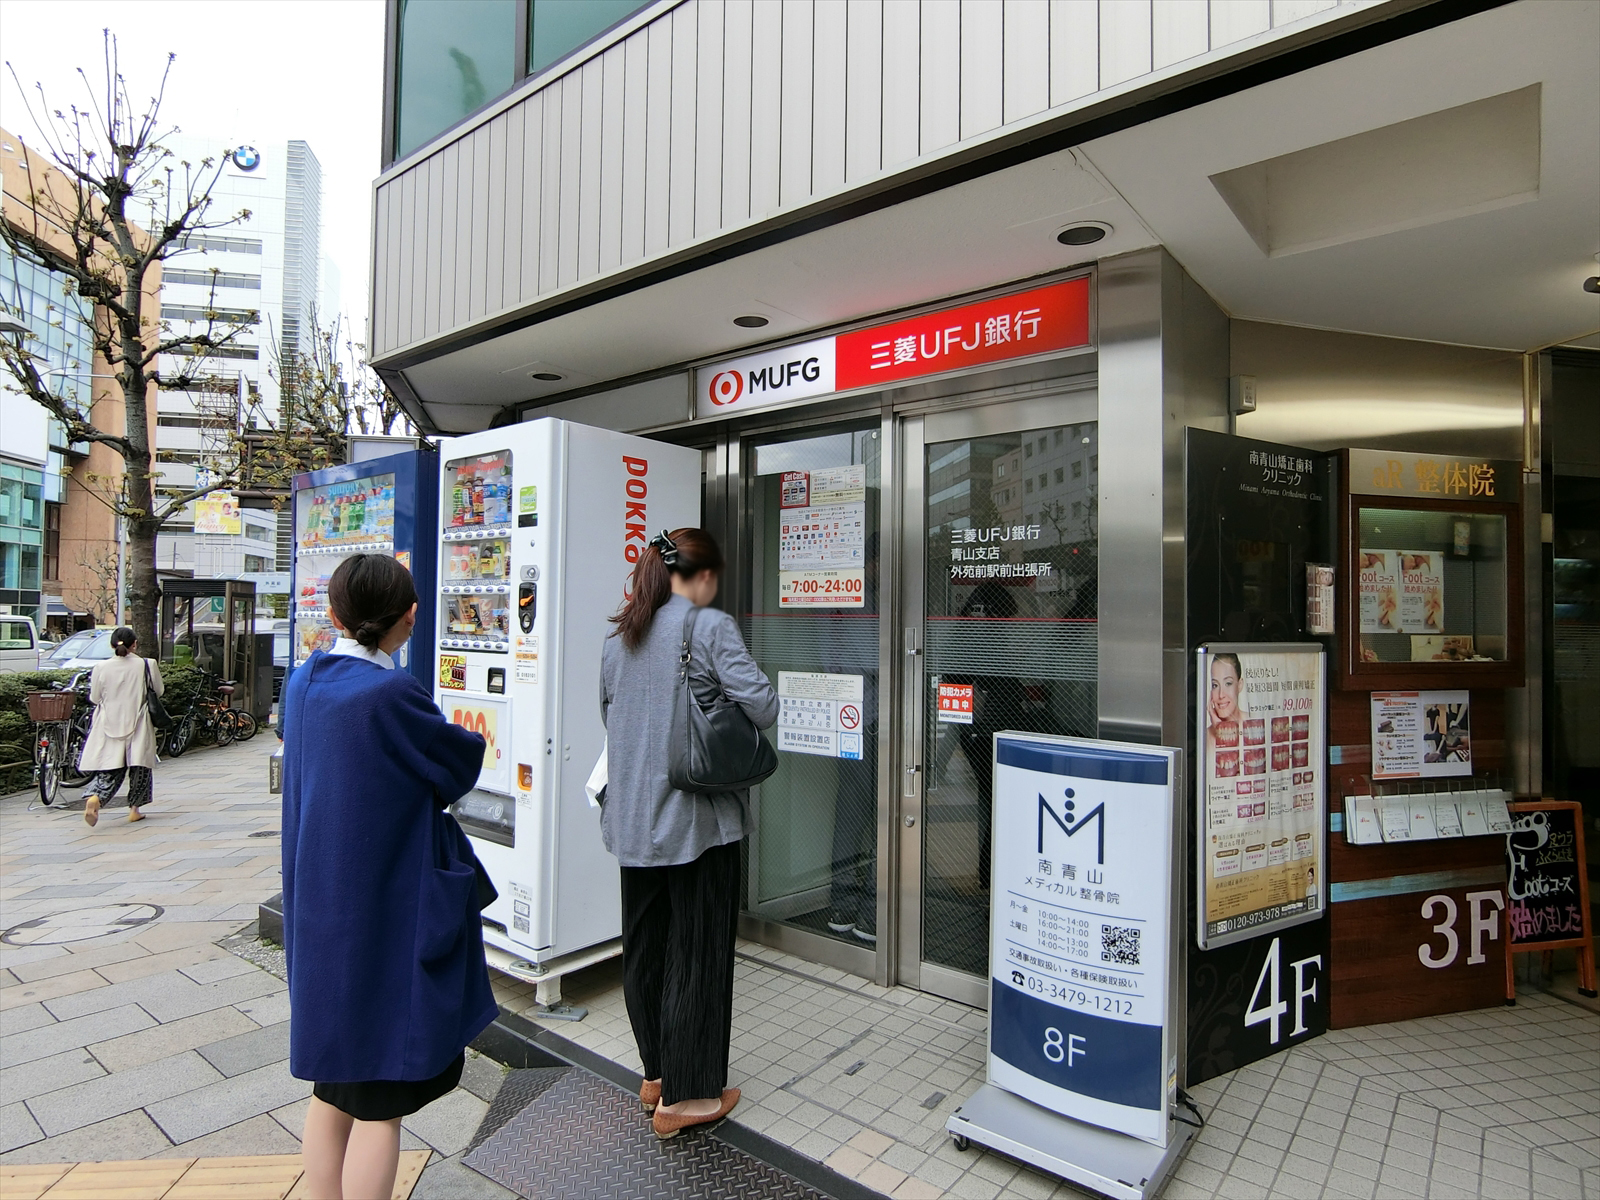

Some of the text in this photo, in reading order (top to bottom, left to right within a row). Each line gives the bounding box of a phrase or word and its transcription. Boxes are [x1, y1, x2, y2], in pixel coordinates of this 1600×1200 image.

[870, 309, 1042, 370] 三菱UFJ銀行
[748, 357, 820, 394] MUFG
[1249, 450, 1313, 474] 南青山矯正歯科
[1262, 468, 1301, 486] クリニック
[1372, 459, 1496, 497] aR 整体院
[950, 524, 1041, 544] 三菱UFJ銀行
[950, 546, 1000, 561] 青山支店
[950, 562, 1052, 579] 外苑前駅前出張所
[1360, 571, 1395, 583] oot コース
[791, 578, 862, 593] 7:00~24:00
[1038, 859, 1103, 885] 南青山
[1025, 876, 1120, 905] メディカル整骨院
[1550, 876, 1575, 894] コース
[1038, 909, 1090, 929] 10:00~14:00
[1038, 918, 1090, 938] 16:00~21:00
[1227, 906, 1280, 930] 0120-973-978
[1418, 890, 1505, 969] 3F
[1509, 899, 1582, 942] 始めました
[1009, 919, 1089, 949] 土曜日 10:00~13:00
[1037, 938, 1089, 958] 14:00~17:00
[1028, 976, 1134, 1016] 03-3479-1212
[1244, 937, 1322, 1045] 4F
[1042, 1026, 1087, 1067] 8F
